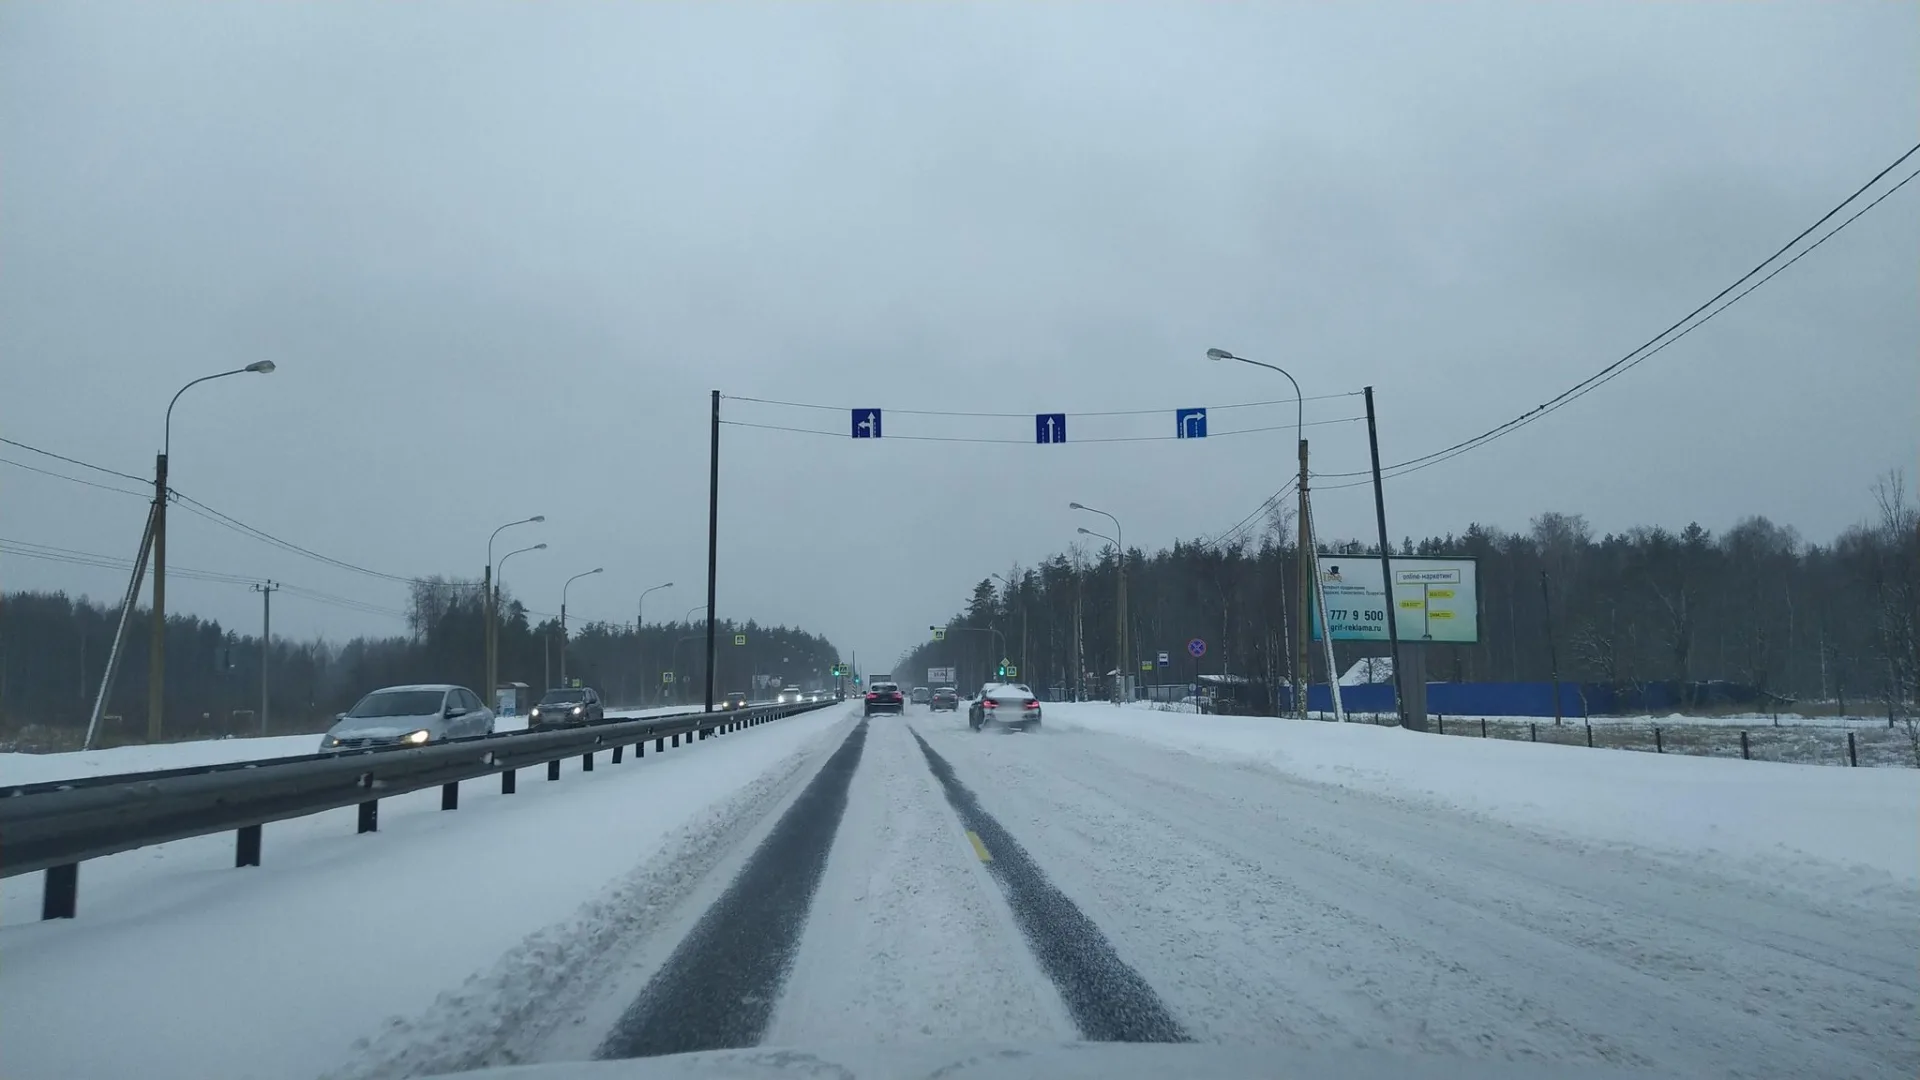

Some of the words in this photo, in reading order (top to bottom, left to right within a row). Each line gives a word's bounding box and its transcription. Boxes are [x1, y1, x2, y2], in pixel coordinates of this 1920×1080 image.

[1330, 610, 1347, 620] 777
[1353, 610, 1359, 620] 9
[1364, 610, 1384, 621] 500
[1330, 624, 1382, 632] grif-reklama.ru
